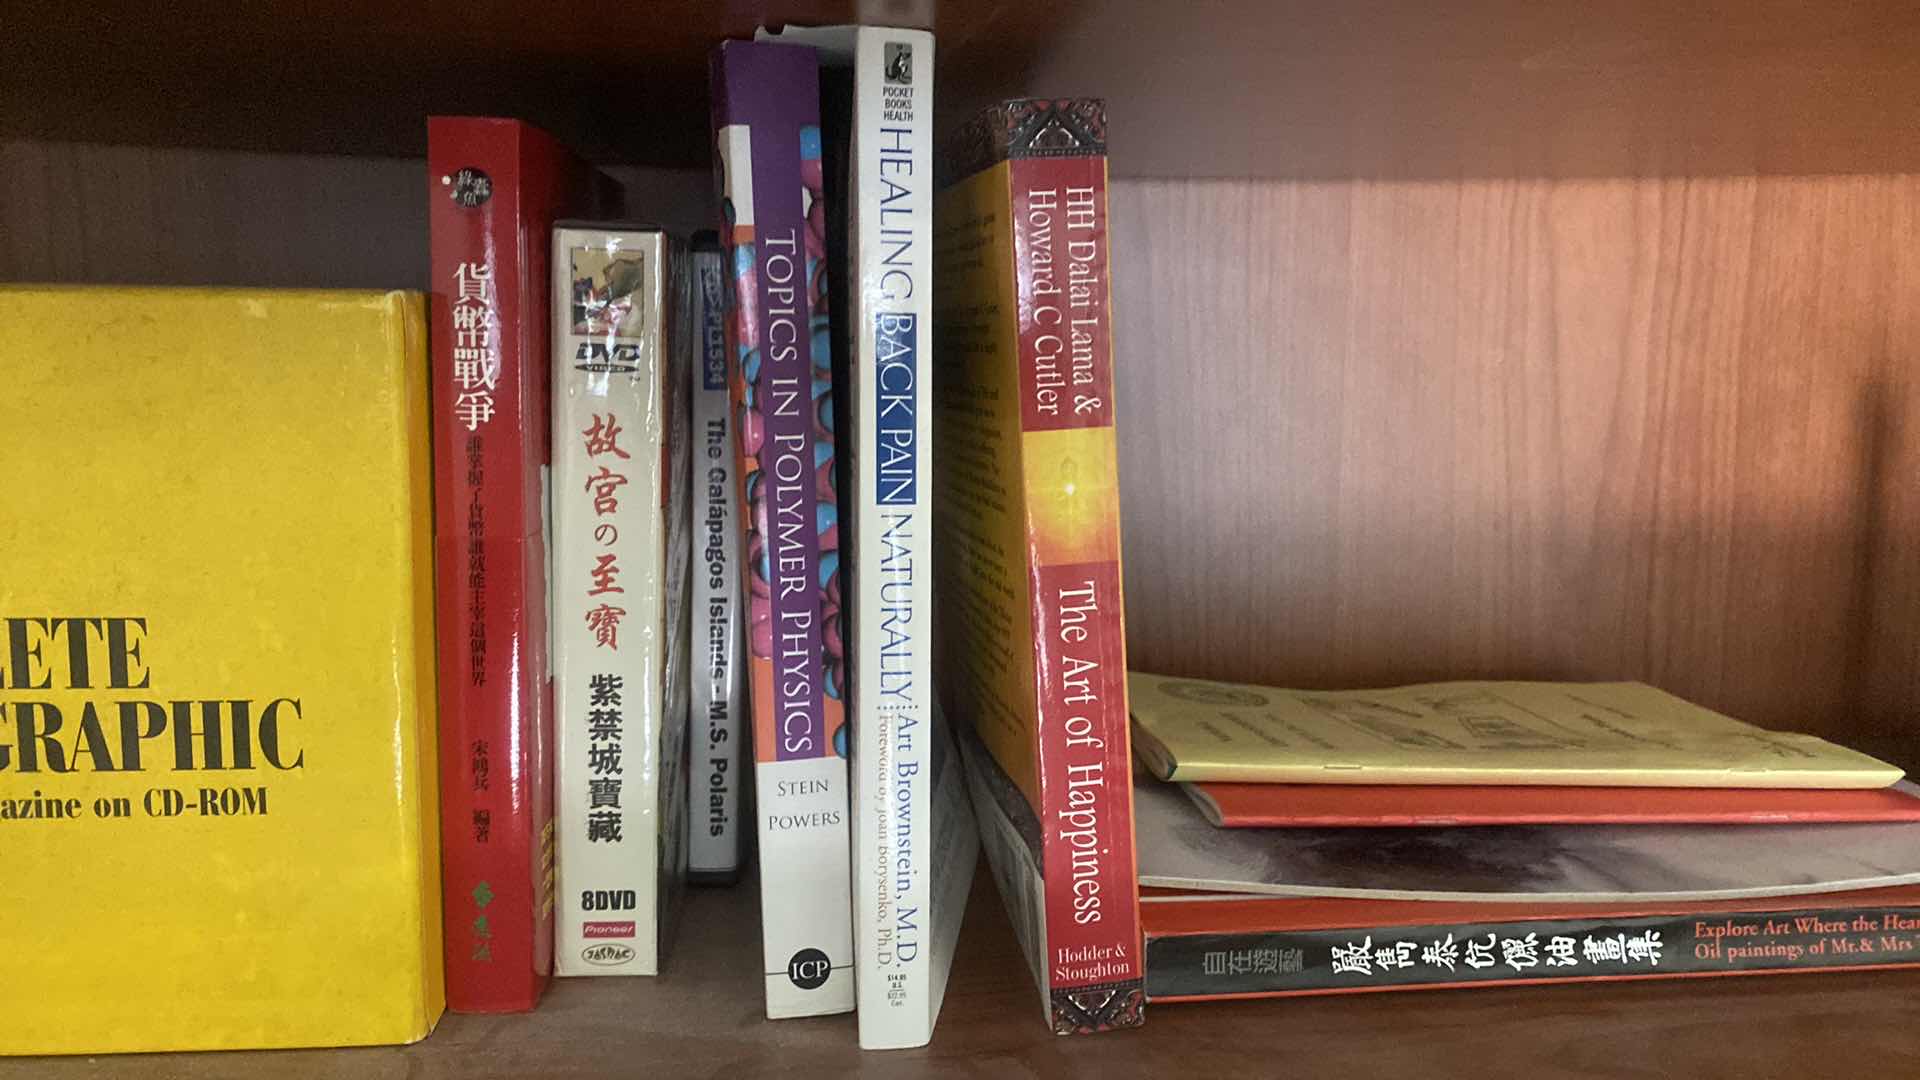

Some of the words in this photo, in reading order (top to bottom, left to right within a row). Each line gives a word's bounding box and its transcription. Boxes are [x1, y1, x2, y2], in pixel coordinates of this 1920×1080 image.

[883, 87, 914, 98] POCKET
[883, 110, 914, 122] HEALTH
[884, 98, 913, 109] BOOKS
[879, 128, 913, 300] HEALING
[1066, 186, 1095, 230] HH
[1027, 187, 1062, 296] Howard
[765, 228, 798, 362] TOPICS
[1067, 240, 1098, 308] Dalai
[1033, 305, 1062, 325] C
[453, 262, 496, 432] 貨幣戰爭
[880, 314, 913, 417] BACK
[1069, 318, 1099, 386] Lama
[771, 378, 800, 417] IN
[1034, 334, 1067, 416] Cutler
[1073, 394, 1102, 415] &
[707, 417, 726, 460] The
[880, 429, 913, 501] PAIN
[581, 412, 631, 651] 故宮の至寶
[704, 466, 728, 590] Galápagos
[773, 432, 808, 600] POLYMER
[880, 513, 913, 702] NATURALLY
[1059, 580, 1099, 643] The
[0, 617, 150, 690] ETE
[709, 597, 728, 680] Islands
[780, 608, 813, 753] PHYSICS
[1062, 655, 1099, 705] Art
[709, 701, 728, 750] M.S.
[897, 714, 919, 752] Art
[1065, 716, 1104, 749] of
[587, 673, 624, 843] 紫禁城寶藏
[94, 797, 131, 818] on
[143, 786, 268, 818] CD-ROM
[709, 758, 728, 838] Polaris
[777, 779, 830, 797] STEIN
[768, 811, 841, 831] POWERS
[893, 761, 919, 900] Brownstein,
[1058, 761, 1109, 924] Happiness
[581, 890, 636, 911] 8DVD
[876, 928, 893, 969] Ph.D.
[895, 907, 918, 968] M.D.
[1058, 945, 1113, 964] Hodder
[1695, 919, 1759, 942] Explore
[1763, 919, 1791, 936] Art
[1794, 916, 1848, 934] Where
[1852, 915, 1879, 931] the
[1695, 942, 1721, 960] Oil
[1727, 940, 1805, 963] paintings
[1809, 938, 1828, 955] of
[1881, 936, 1913, 952] Mrs
[791, 961, 829, 980] ICP
[1055, 961, 1130, 981] Stoughton
